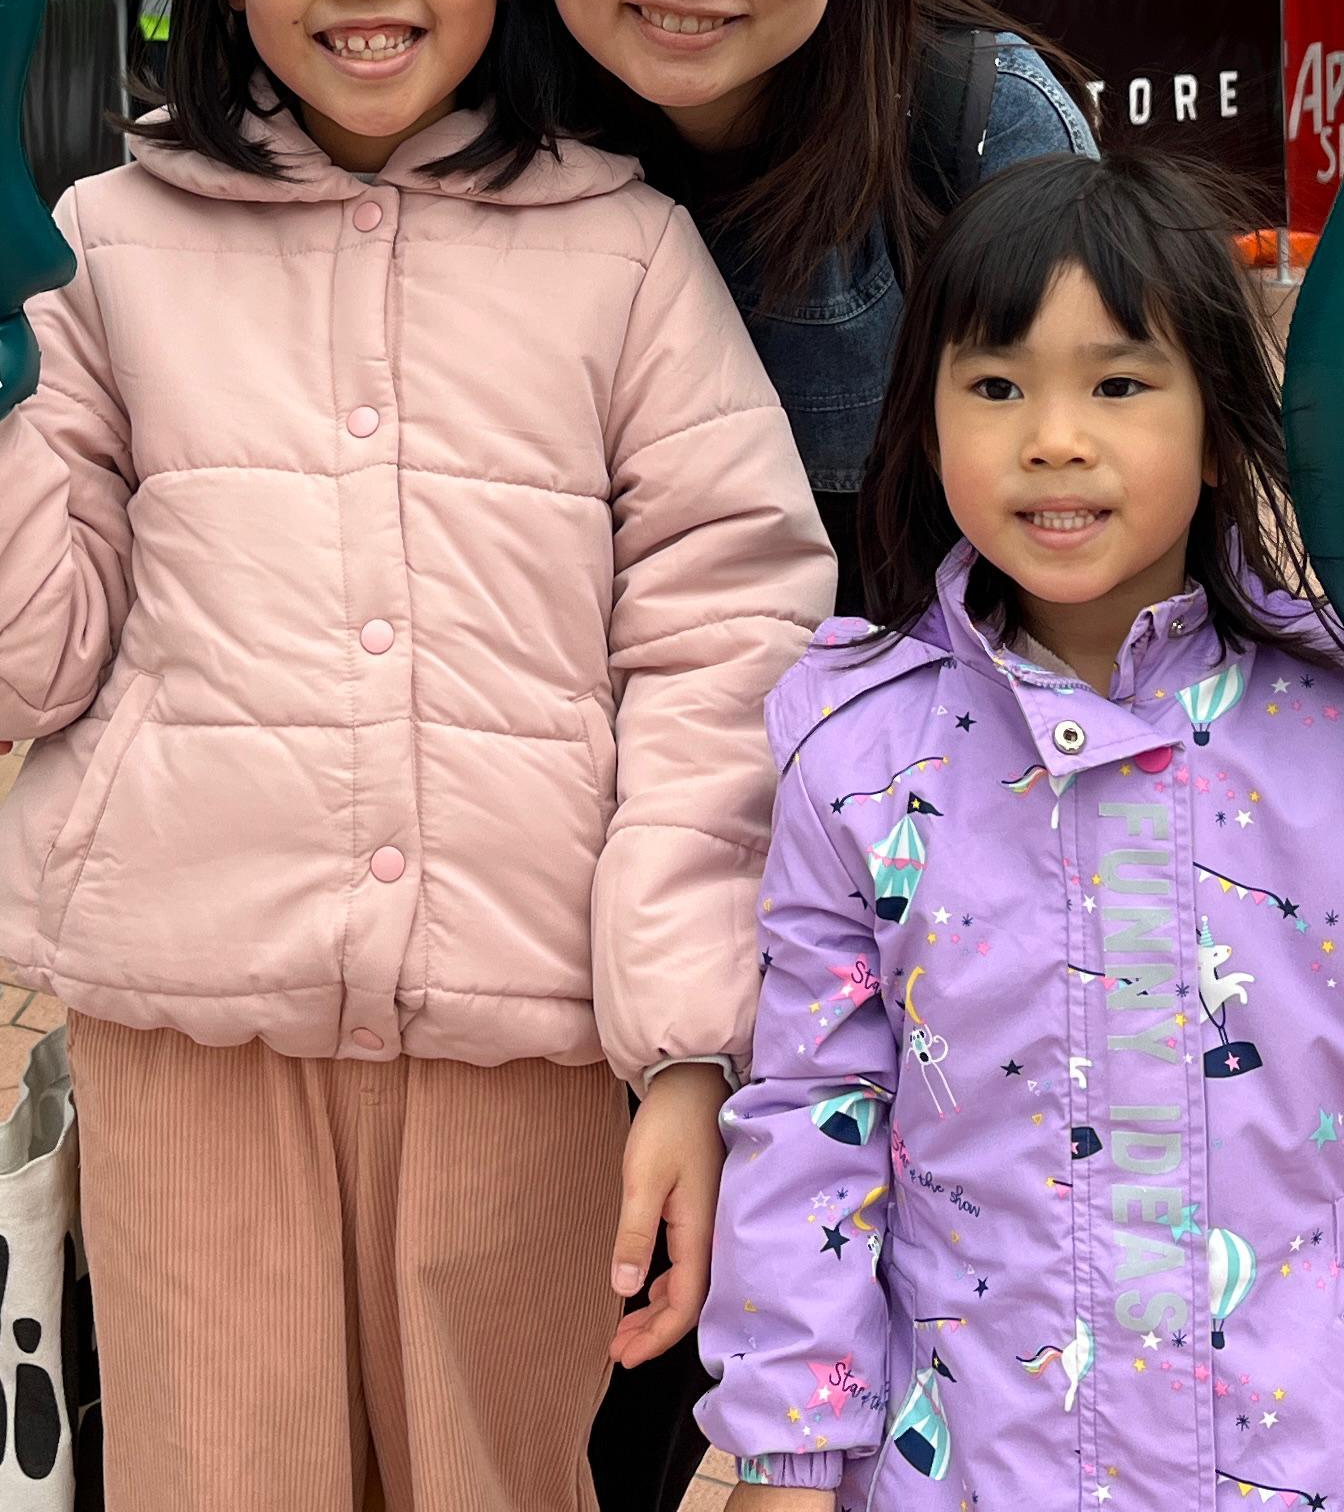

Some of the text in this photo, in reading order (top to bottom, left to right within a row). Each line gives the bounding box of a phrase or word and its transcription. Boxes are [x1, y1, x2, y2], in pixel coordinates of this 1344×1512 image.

[949, 1184, 981, 1218] show
[1097, 801, 1189, 1334] FUNNY IDEAS
